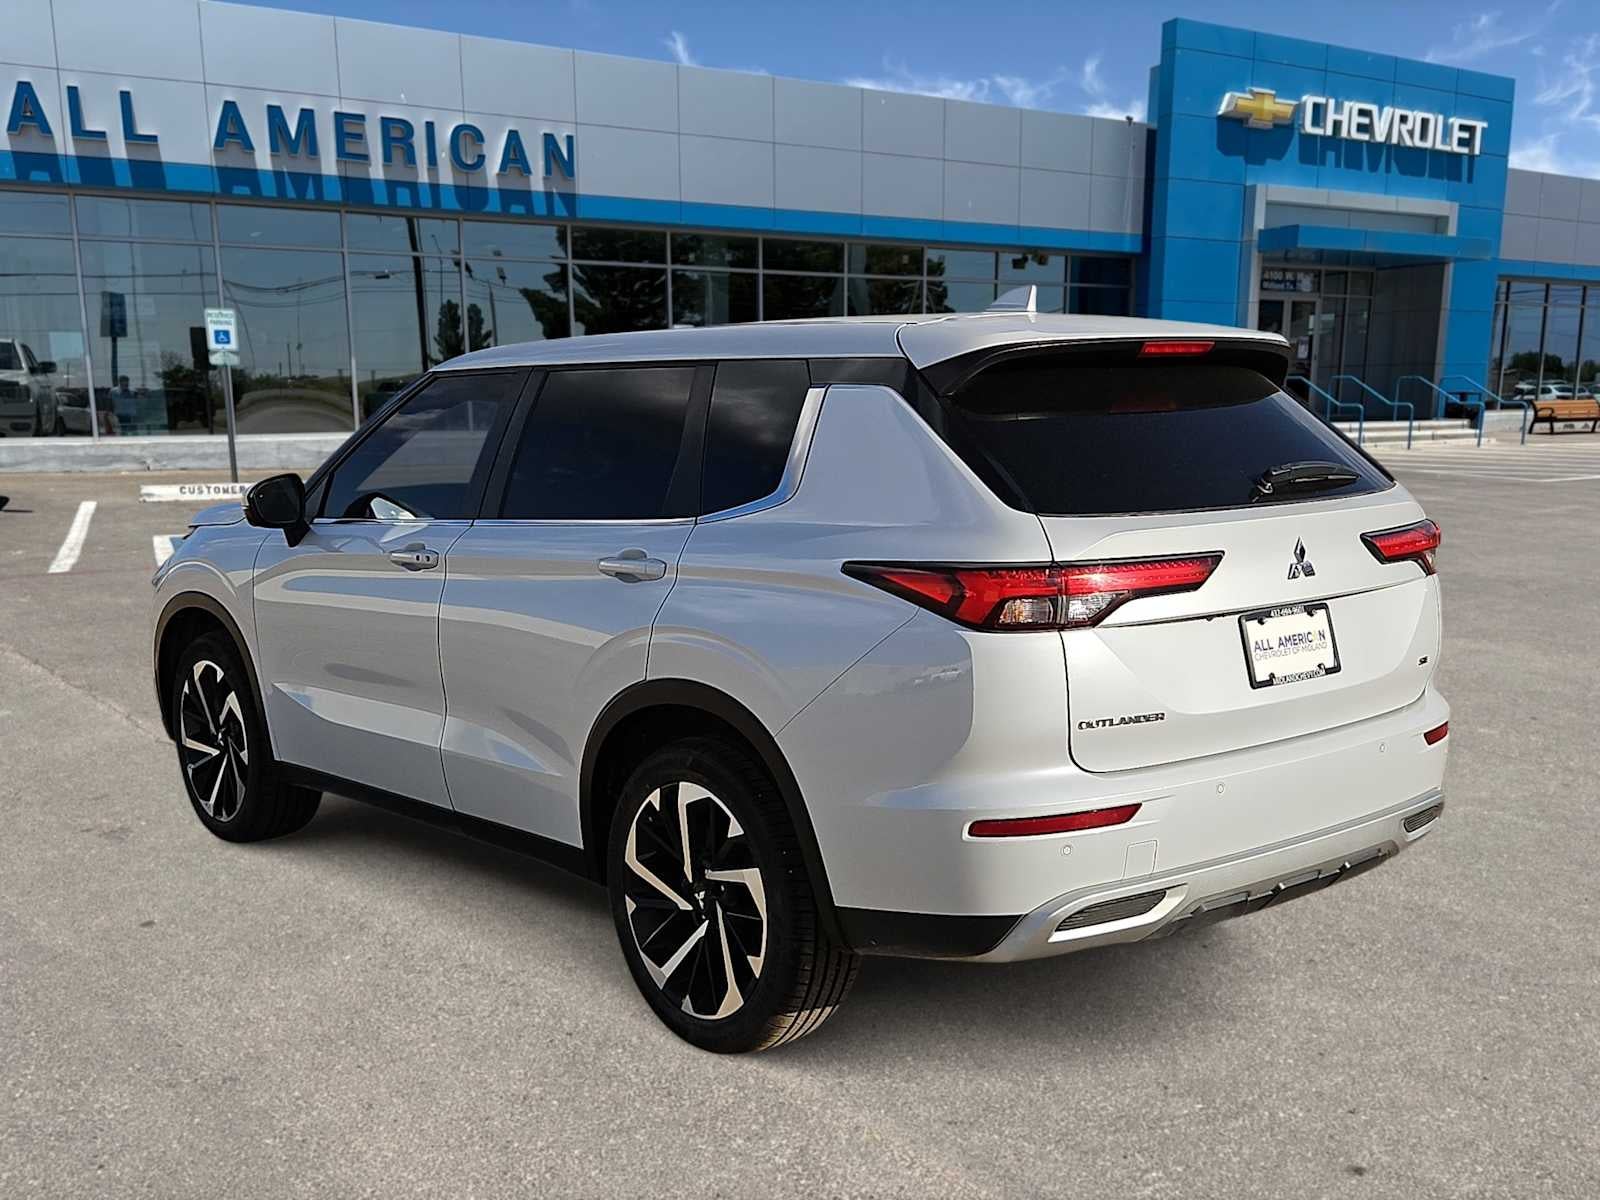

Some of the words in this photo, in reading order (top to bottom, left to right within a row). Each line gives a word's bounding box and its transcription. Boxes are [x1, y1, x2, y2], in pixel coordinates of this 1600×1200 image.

[7, 80, 159, 144] ALL
[213, 99, 576, 178] AMERICAN
[1301, 94, 1489, 155] CHEVROLET
[179, 486, 246, 495] CUSTOMER
[1254, 638, 1274, 653] ALL
[1254, 647, 1291, 661] CHEVROLET
[1078, 712, 1165, 730] OUTLANDER
